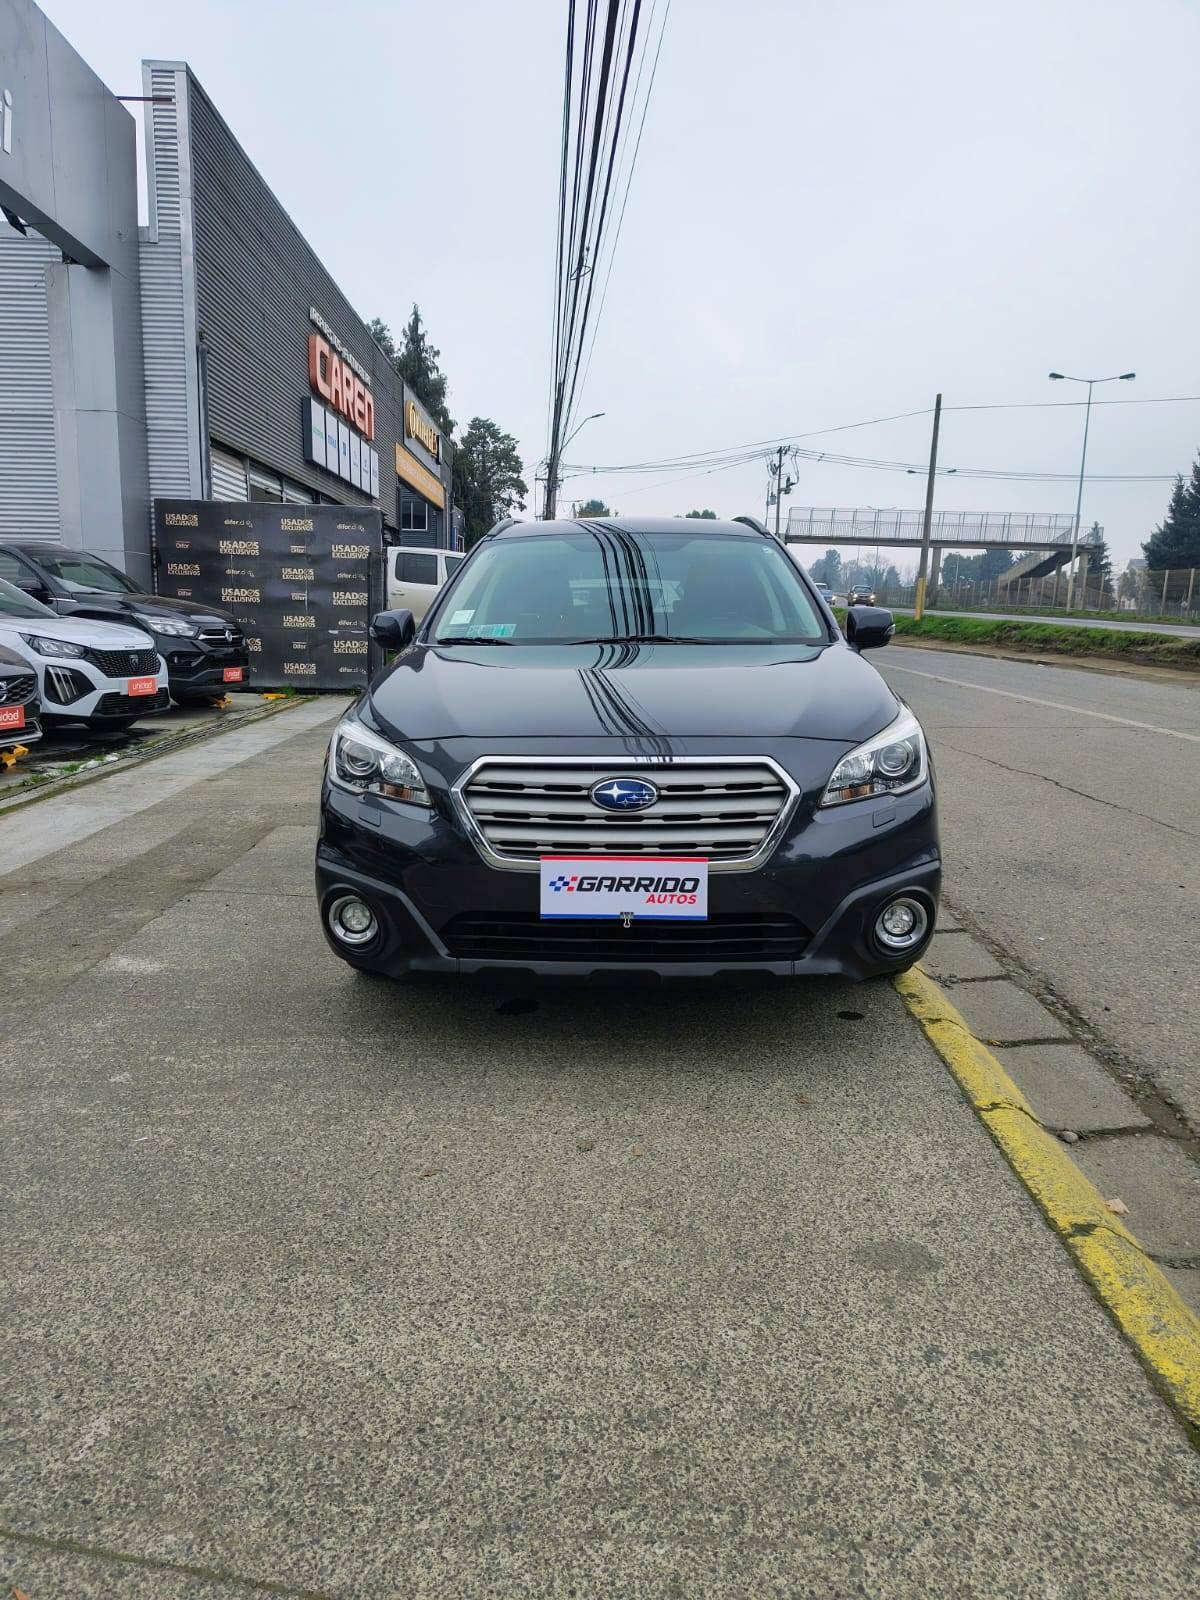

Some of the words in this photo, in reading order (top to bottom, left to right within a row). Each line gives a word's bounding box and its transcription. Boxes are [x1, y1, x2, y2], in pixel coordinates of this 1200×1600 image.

[309, 334, 374, 441] CAREN
[220, 541, 259, 550] USADOS
[332, 545, 370, 553] USADOS
[222, 588, 260, 597] USADOS
[577, 876, 700, 893] GARRIDO
[646, 894, 697, 904] AUTOS
